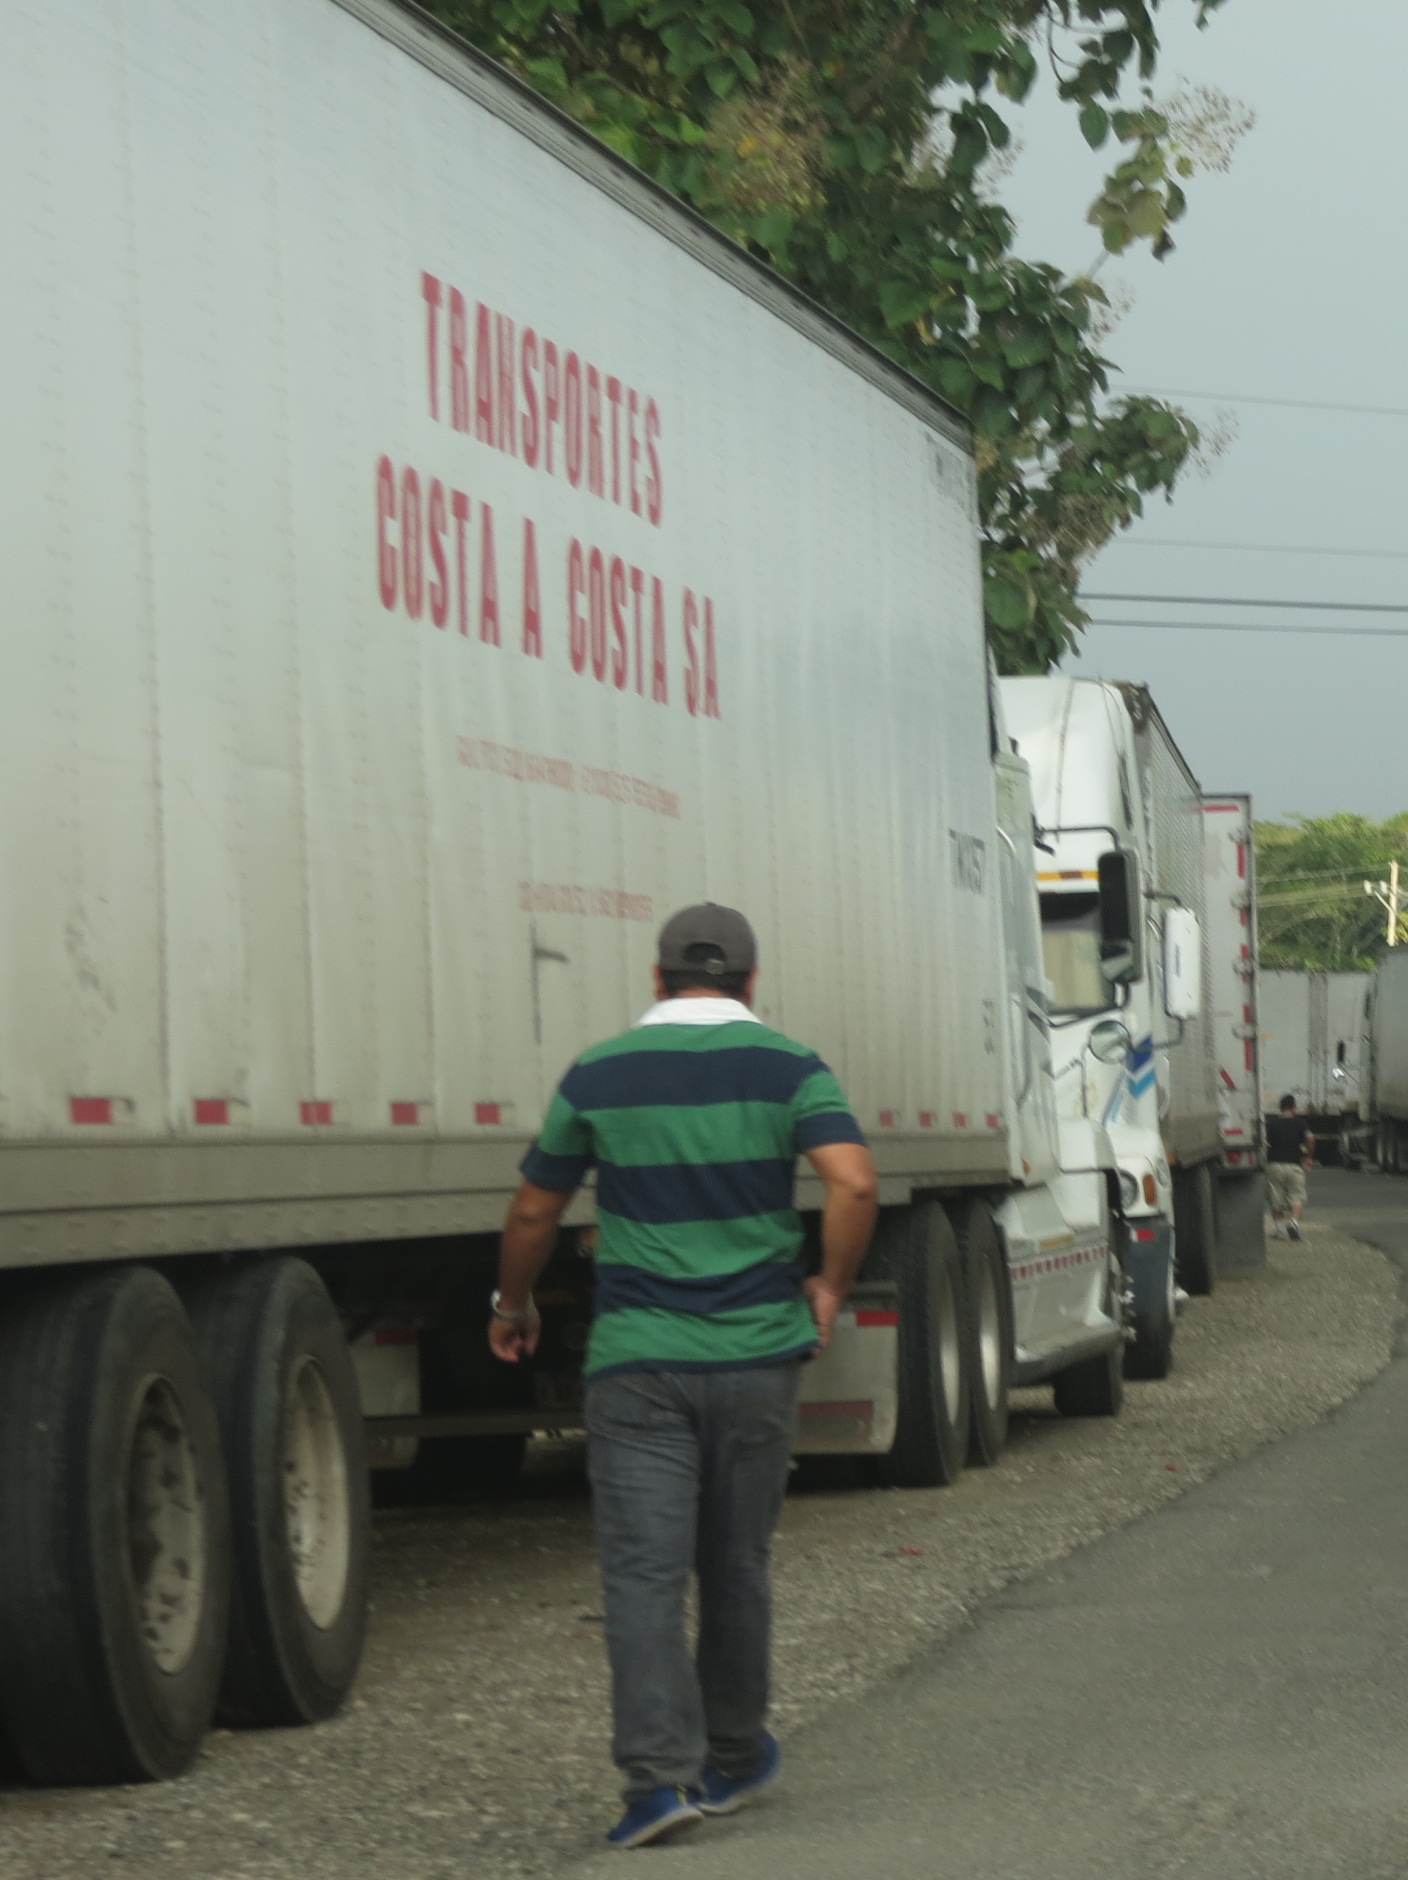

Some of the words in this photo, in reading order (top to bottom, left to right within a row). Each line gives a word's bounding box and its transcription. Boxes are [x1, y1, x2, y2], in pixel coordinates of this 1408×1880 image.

[421, 269, 662, 529] TRANSPORTES
[376, 453, 501, 649] COSTA
[521, 516, 544, 659] A
[567, 535, 668, 706] COSTA
[682, 585, 721, 720] SA
